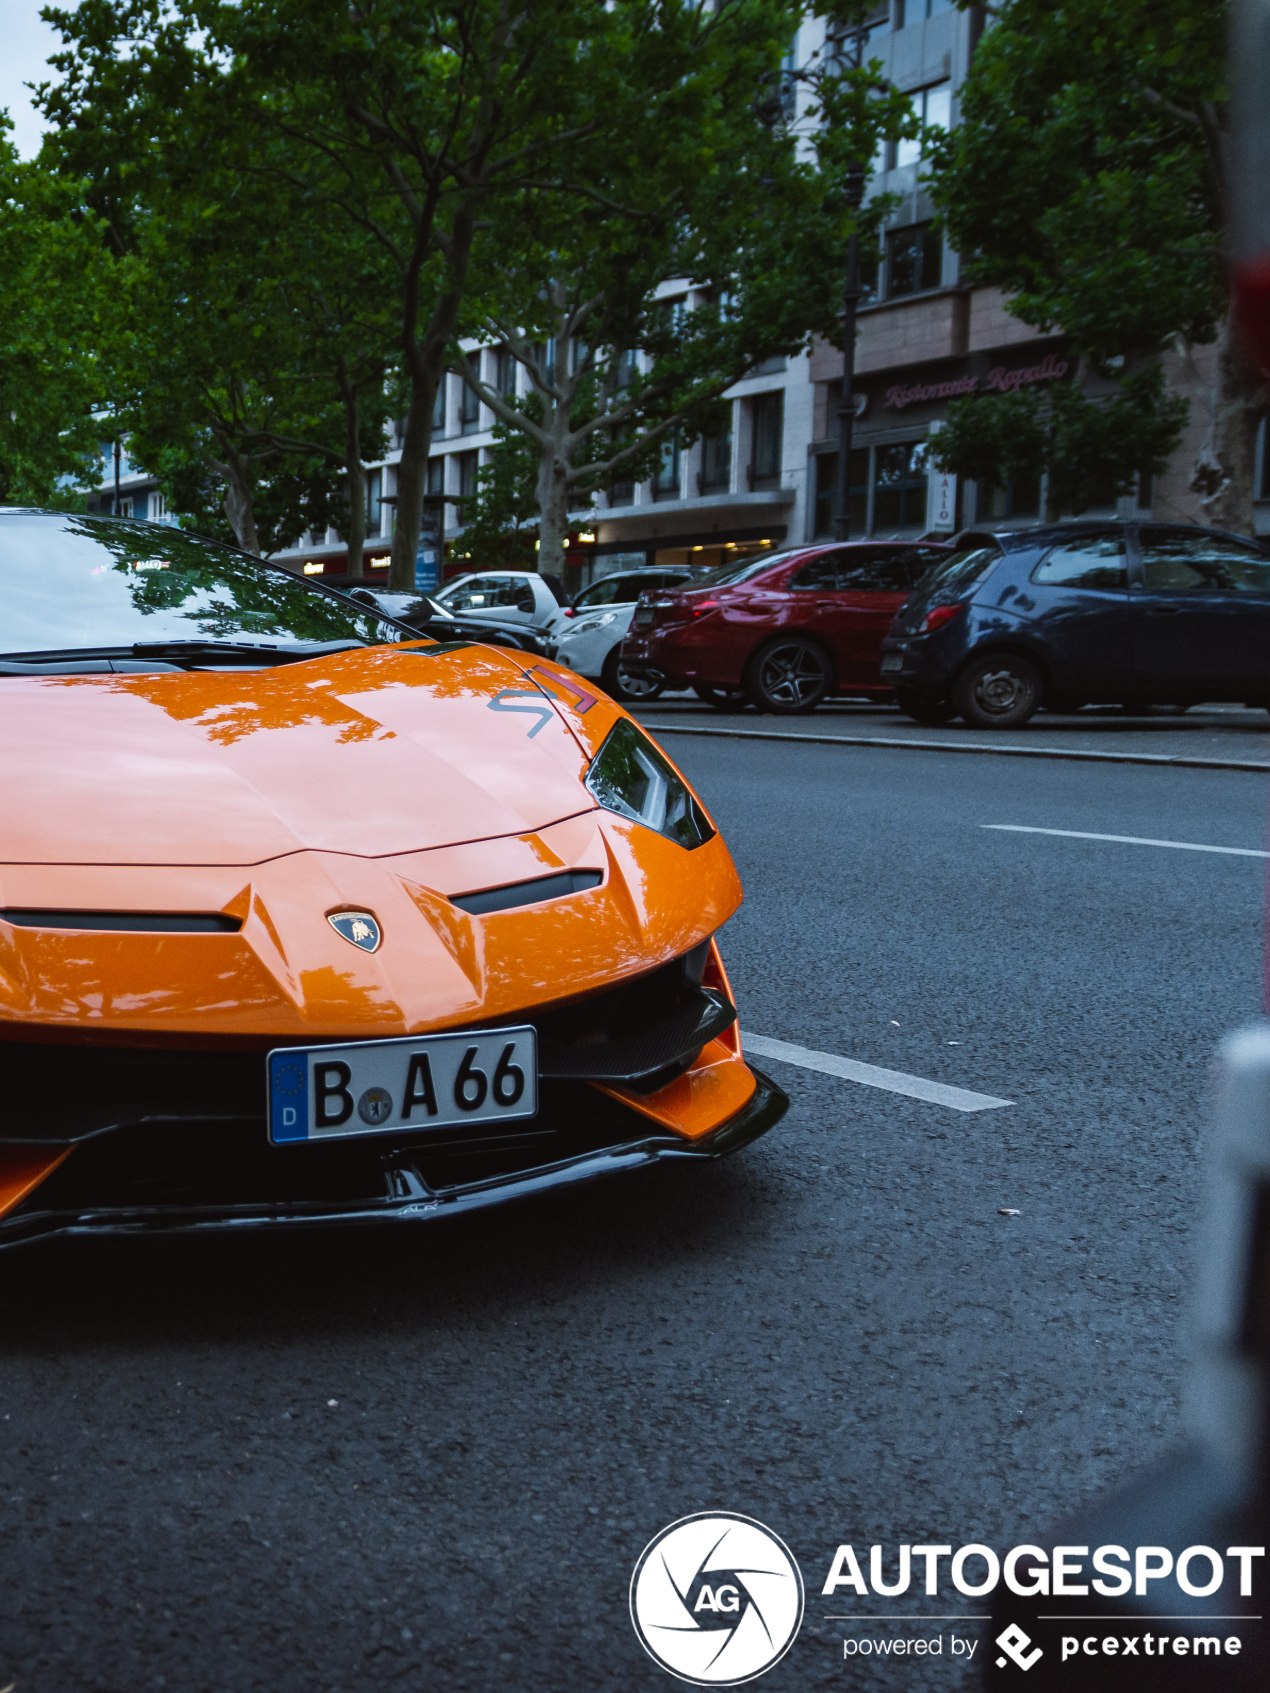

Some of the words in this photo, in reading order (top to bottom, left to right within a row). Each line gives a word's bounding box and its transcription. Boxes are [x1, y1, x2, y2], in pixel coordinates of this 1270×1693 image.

[886, 376, 980, 408] Ristorante
[987, 355, 1068, 392] Rapallo
[314, 1060, 354, 1128] B
[401, 1051, 439, 1119] A
[454, 1042, 525, 1112] 66
[282, 1107, 297, 1126] D
